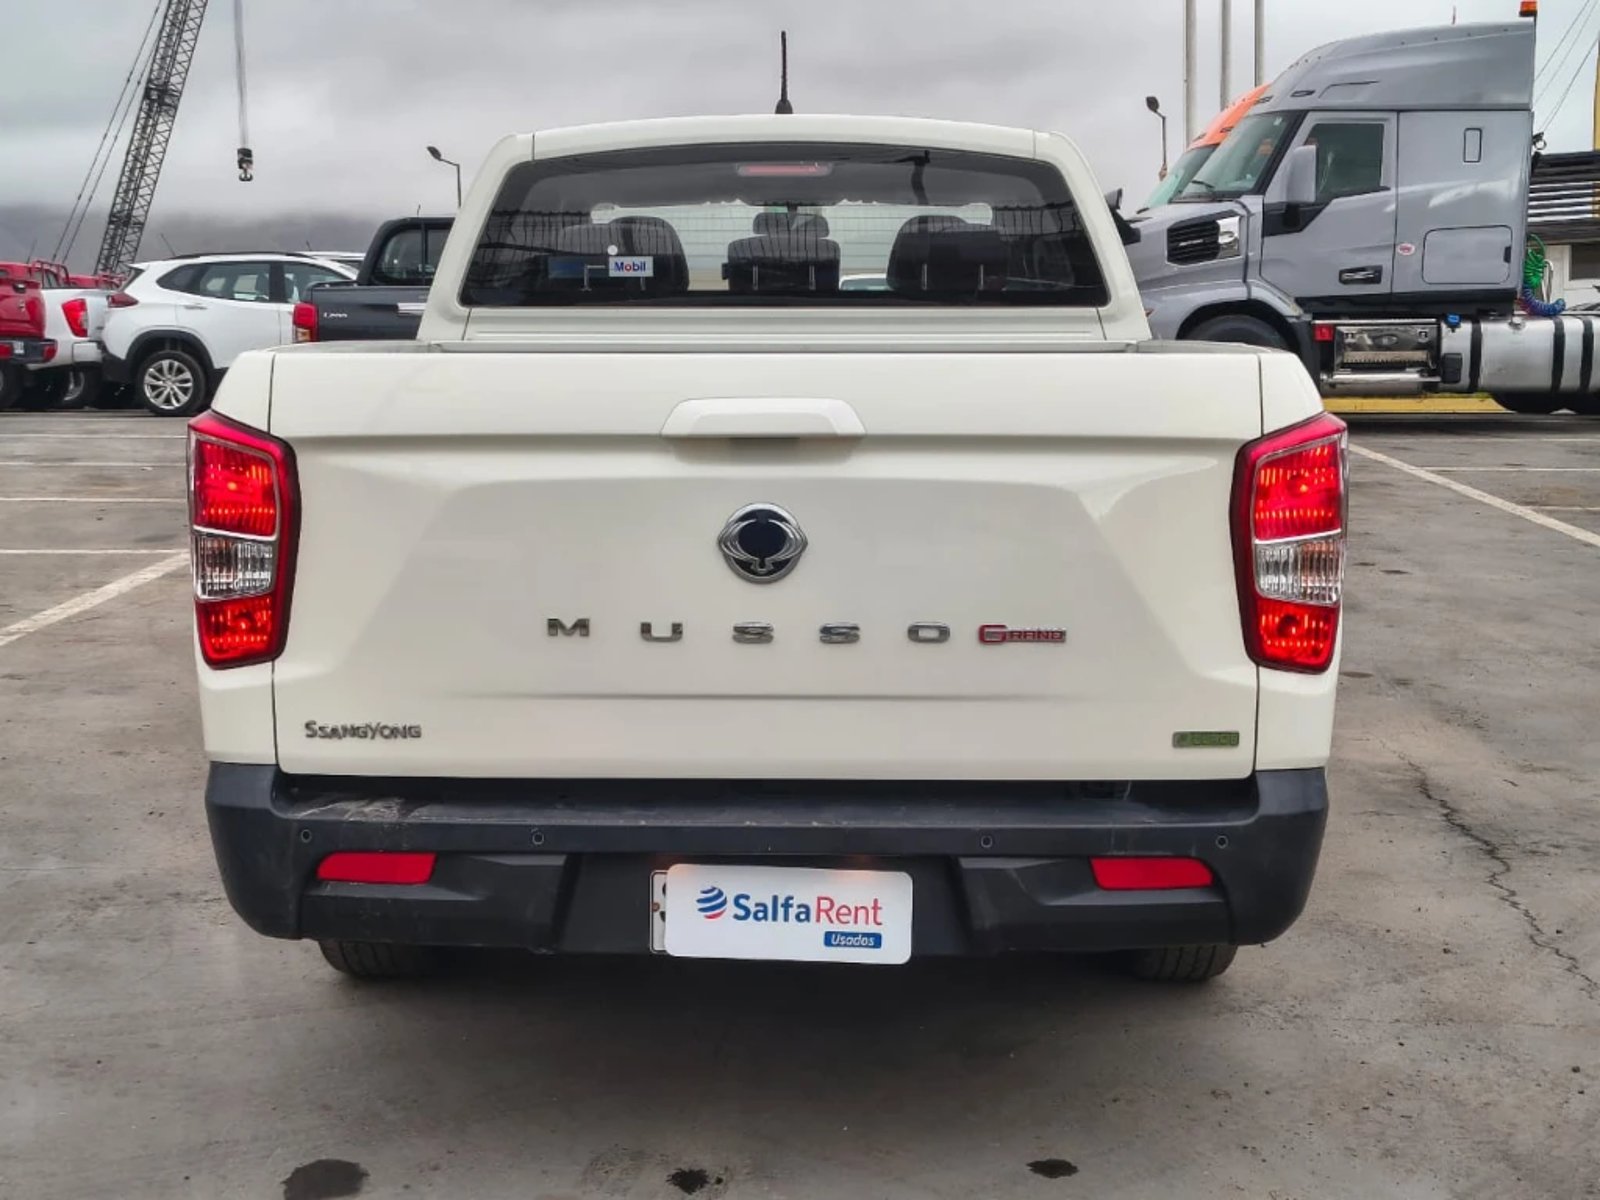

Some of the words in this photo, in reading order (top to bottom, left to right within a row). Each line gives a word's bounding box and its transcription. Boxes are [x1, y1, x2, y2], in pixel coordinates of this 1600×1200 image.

[614, 261, 647, 272] Mobil
[547, 618, 950, 645] MUSSO
[978, 624, 1067, 645] GRAND
[732, 892, 884, 927] SalfaRent
[831, 933, 876, 947] Usados
